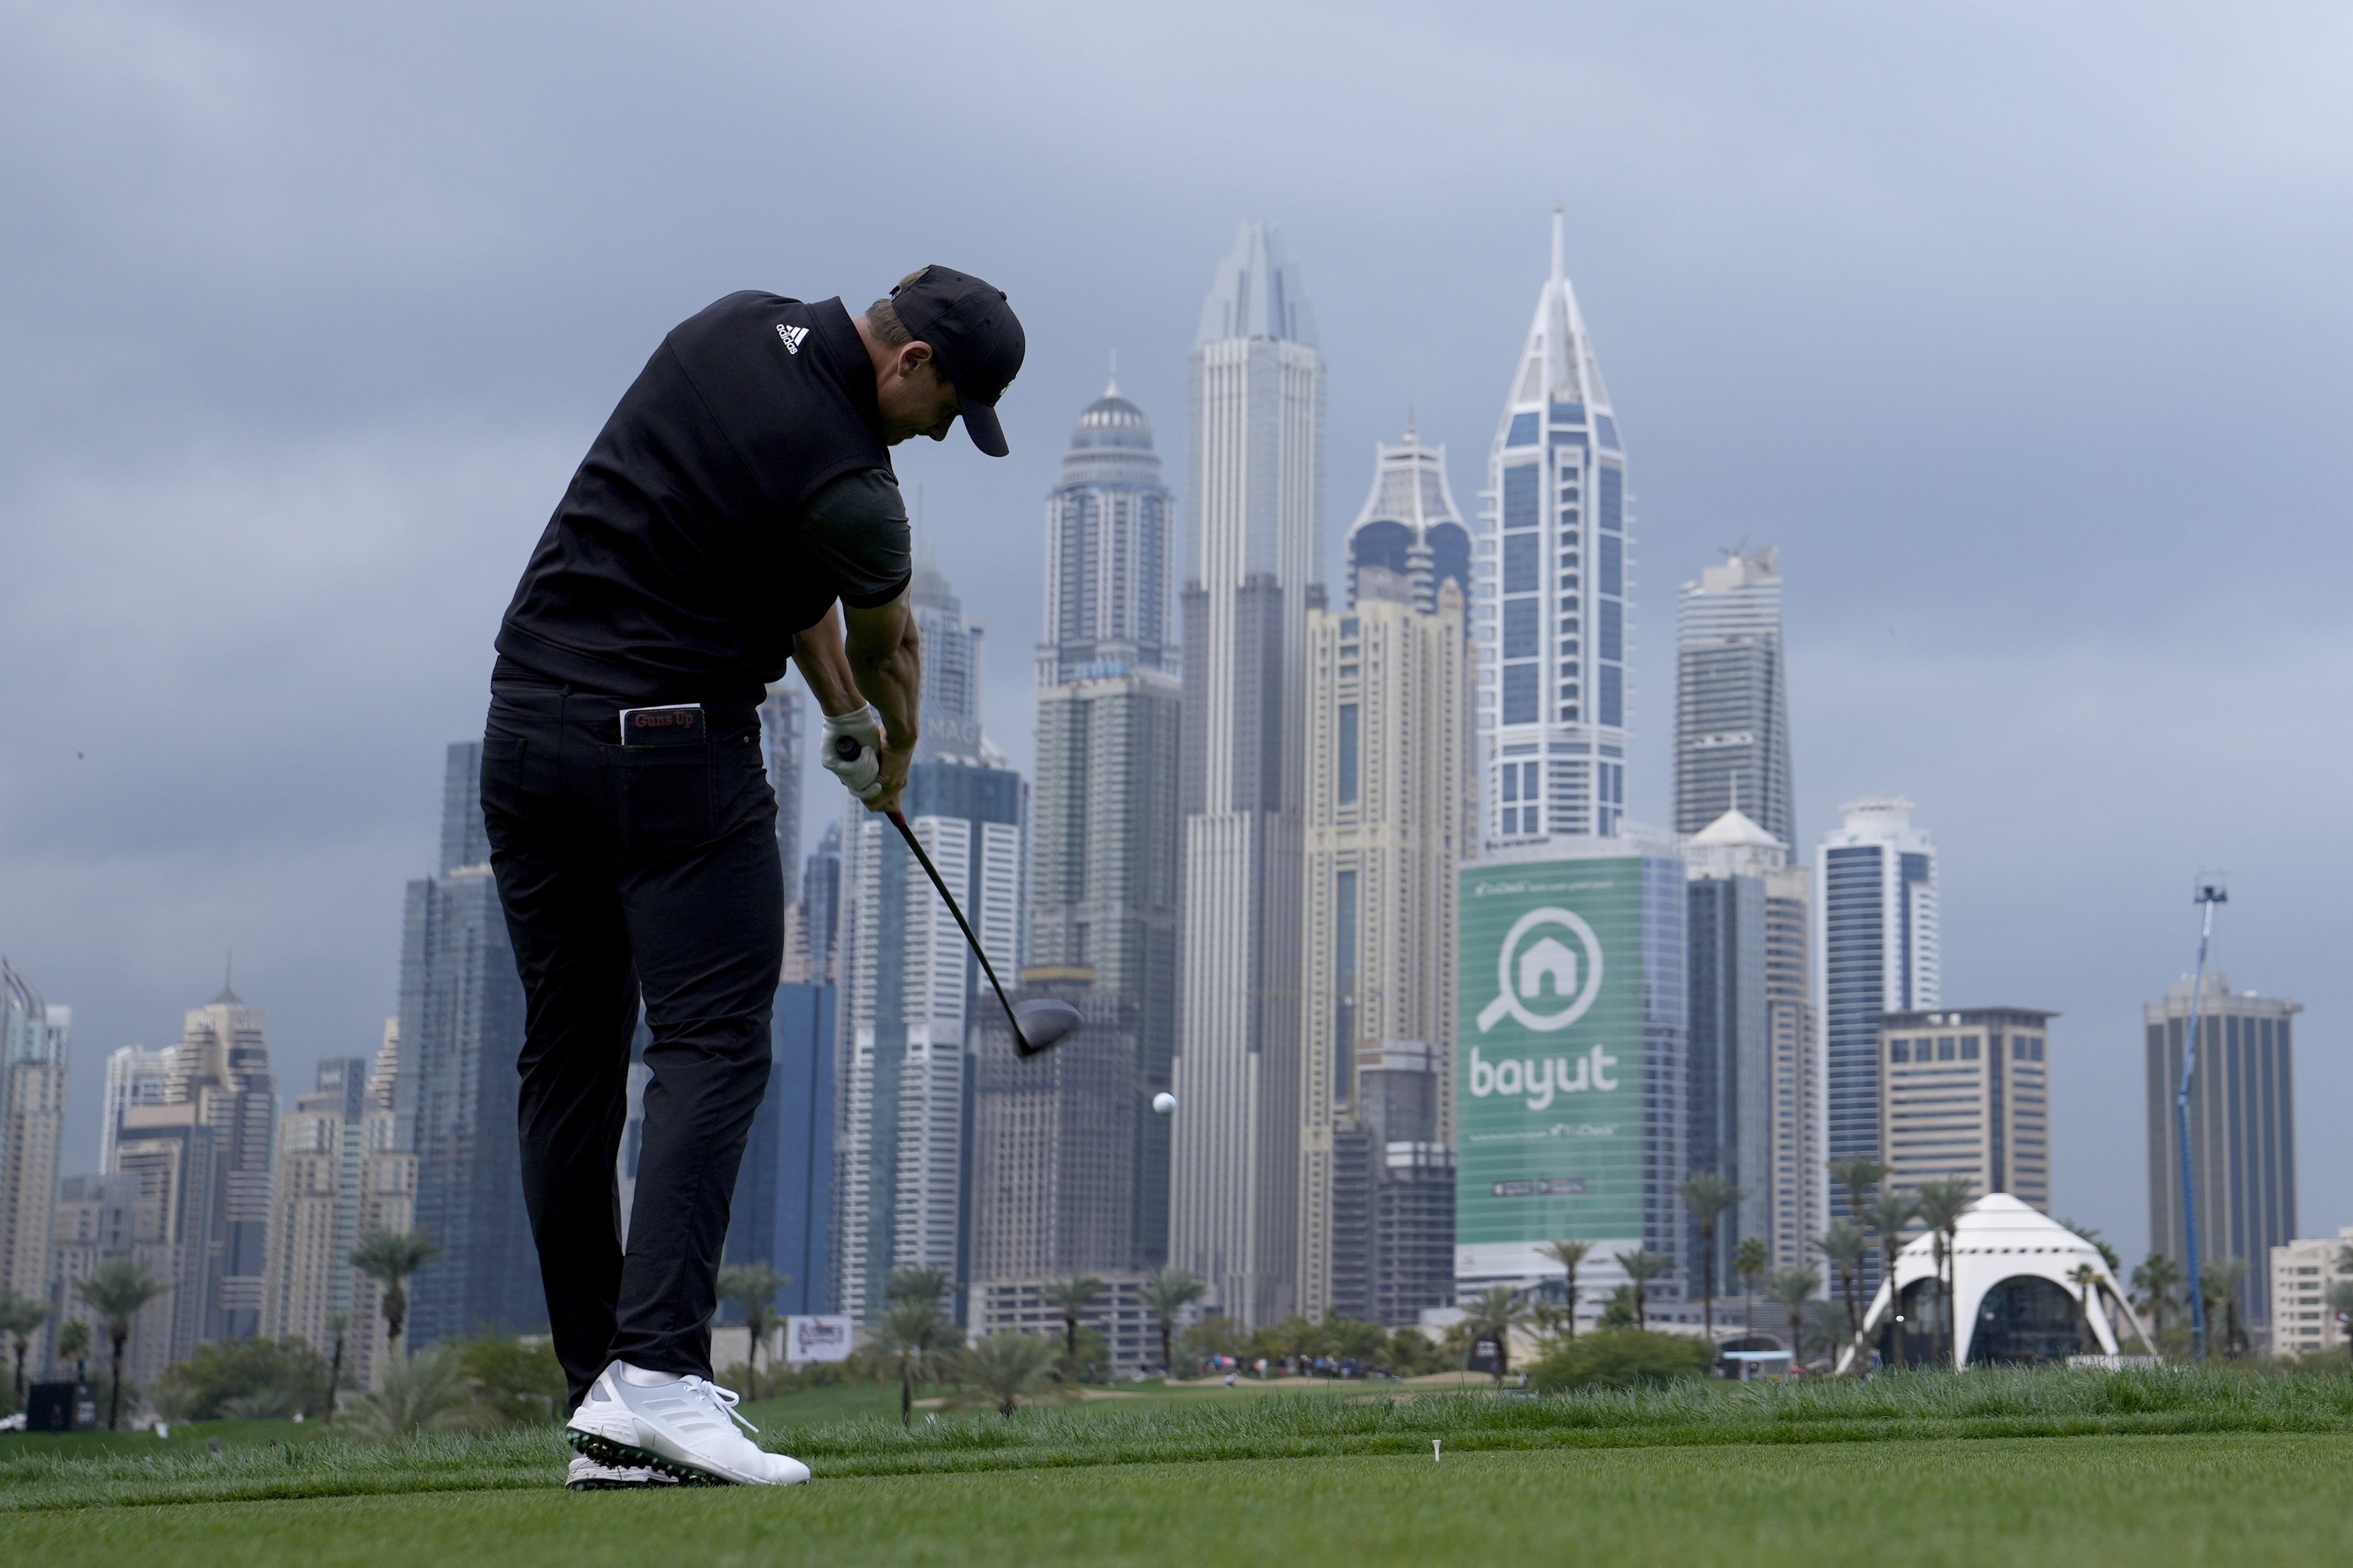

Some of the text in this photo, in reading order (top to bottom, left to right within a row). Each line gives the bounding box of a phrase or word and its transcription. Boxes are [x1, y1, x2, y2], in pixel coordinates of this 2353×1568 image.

[776, 323, 798, 355] adidas
[635, 712, 694, 728] Guns Up
[1470, 1043, 1618, 1110] bayut
